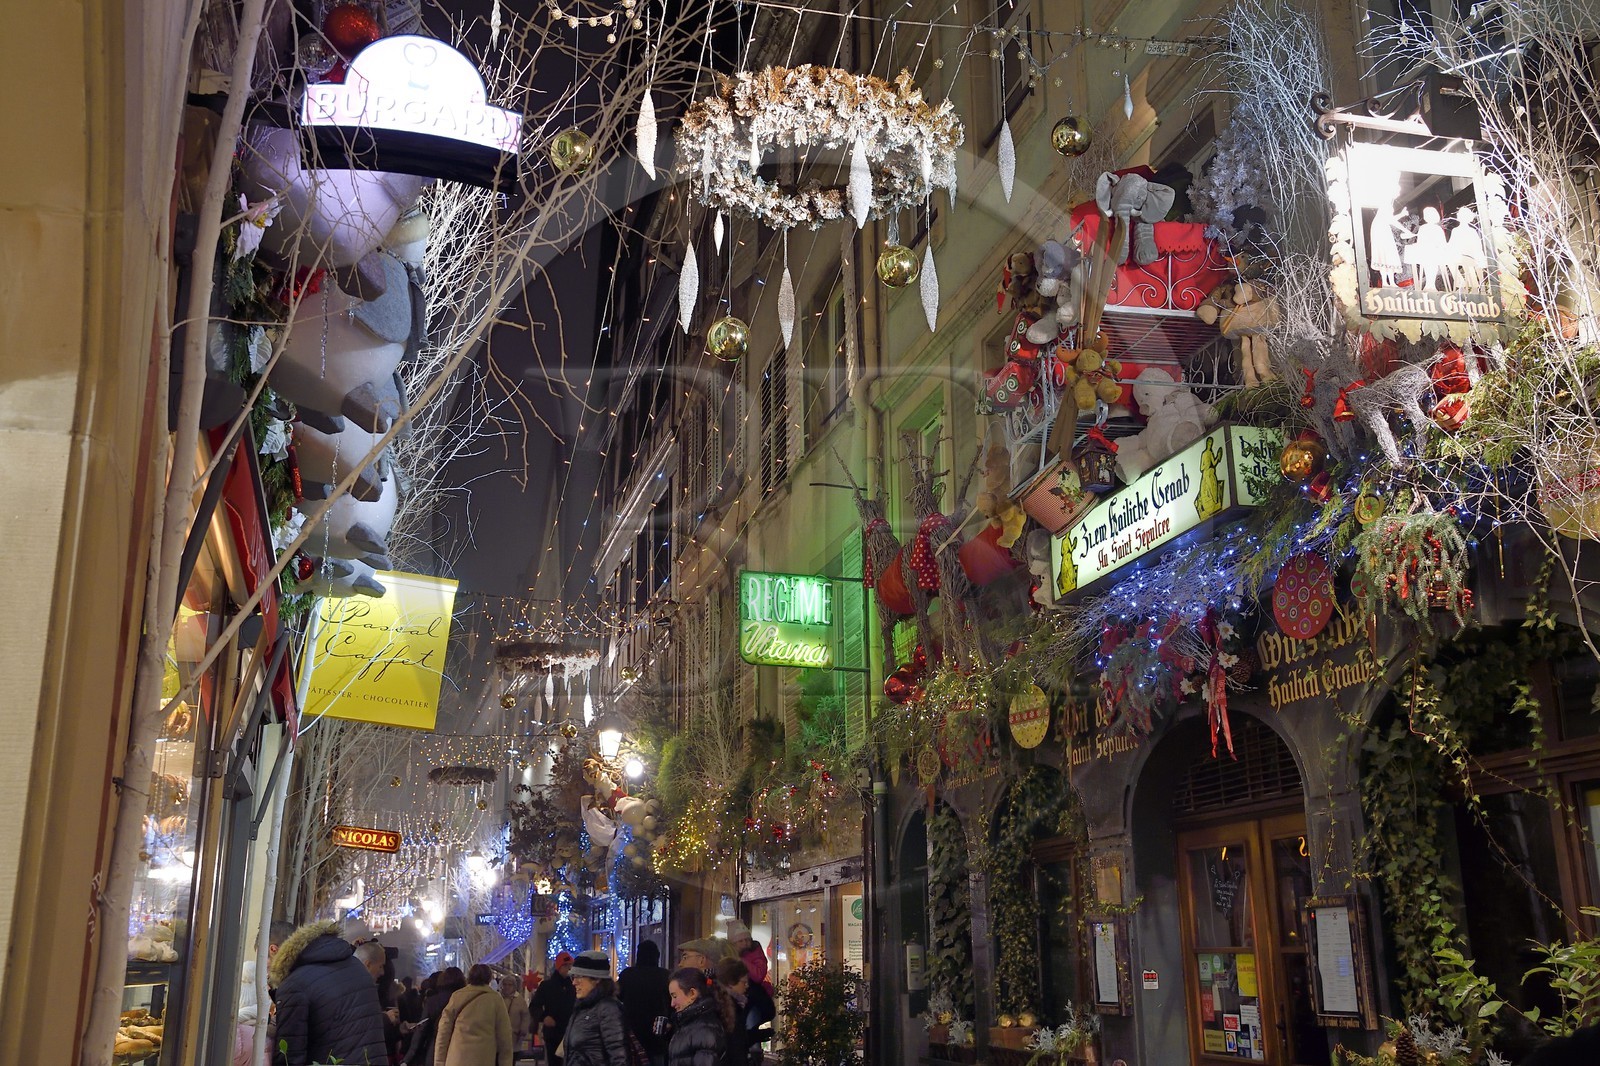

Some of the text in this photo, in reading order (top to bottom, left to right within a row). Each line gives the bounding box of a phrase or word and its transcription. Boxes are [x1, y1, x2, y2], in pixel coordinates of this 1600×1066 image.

[314, 90, 512, 142] BURGARD
[1364, 287, 1501, 318] Hailich Graab
[320, 600, 442, 638] Pascal
[315, 630, 435, 683] Caffet
[363, 694, 429, 708] CHOCOLATIER
[337, 829, 396, 848] NICOLAS
